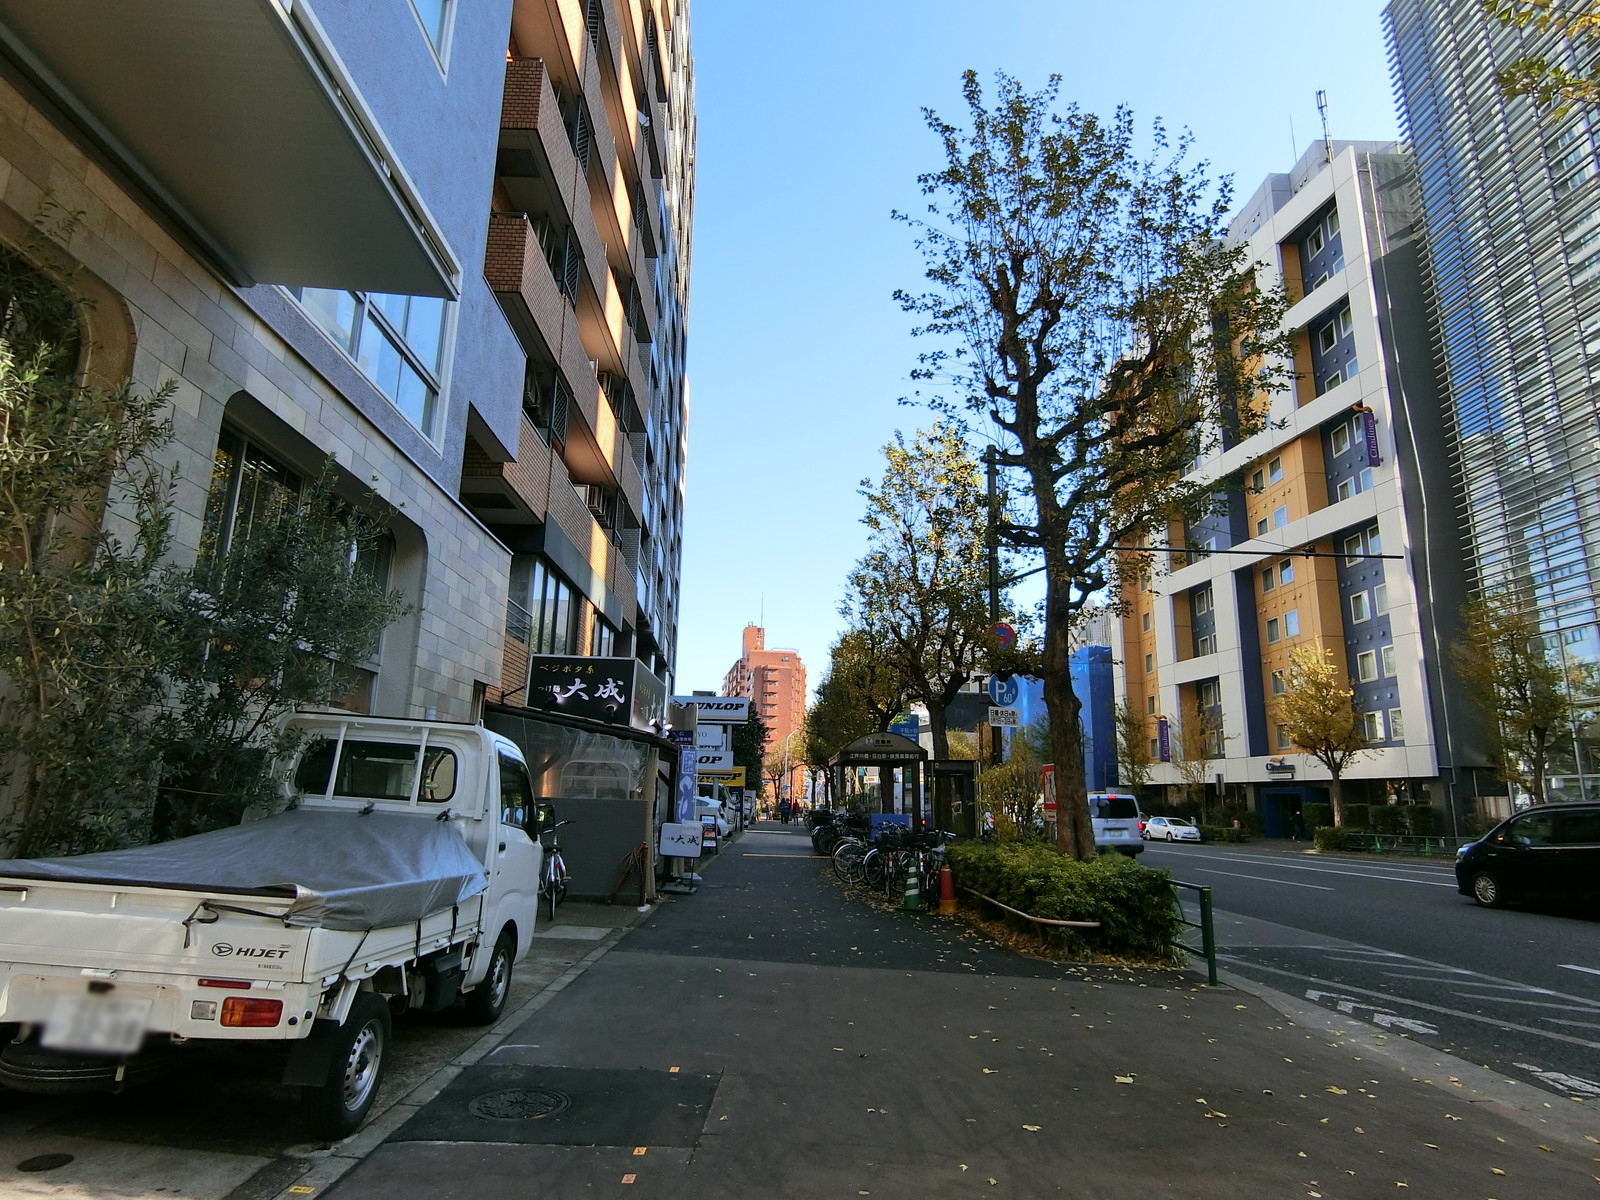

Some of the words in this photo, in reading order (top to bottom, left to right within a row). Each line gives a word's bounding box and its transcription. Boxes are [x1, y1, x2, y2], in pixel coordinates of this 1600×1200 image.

[1367, 420, 1378, 458] Citadines
[562, 678, 625, 704] 大成
[675, 835, 700, 846] 大成
[236, 947, 289, 958] HIJET
